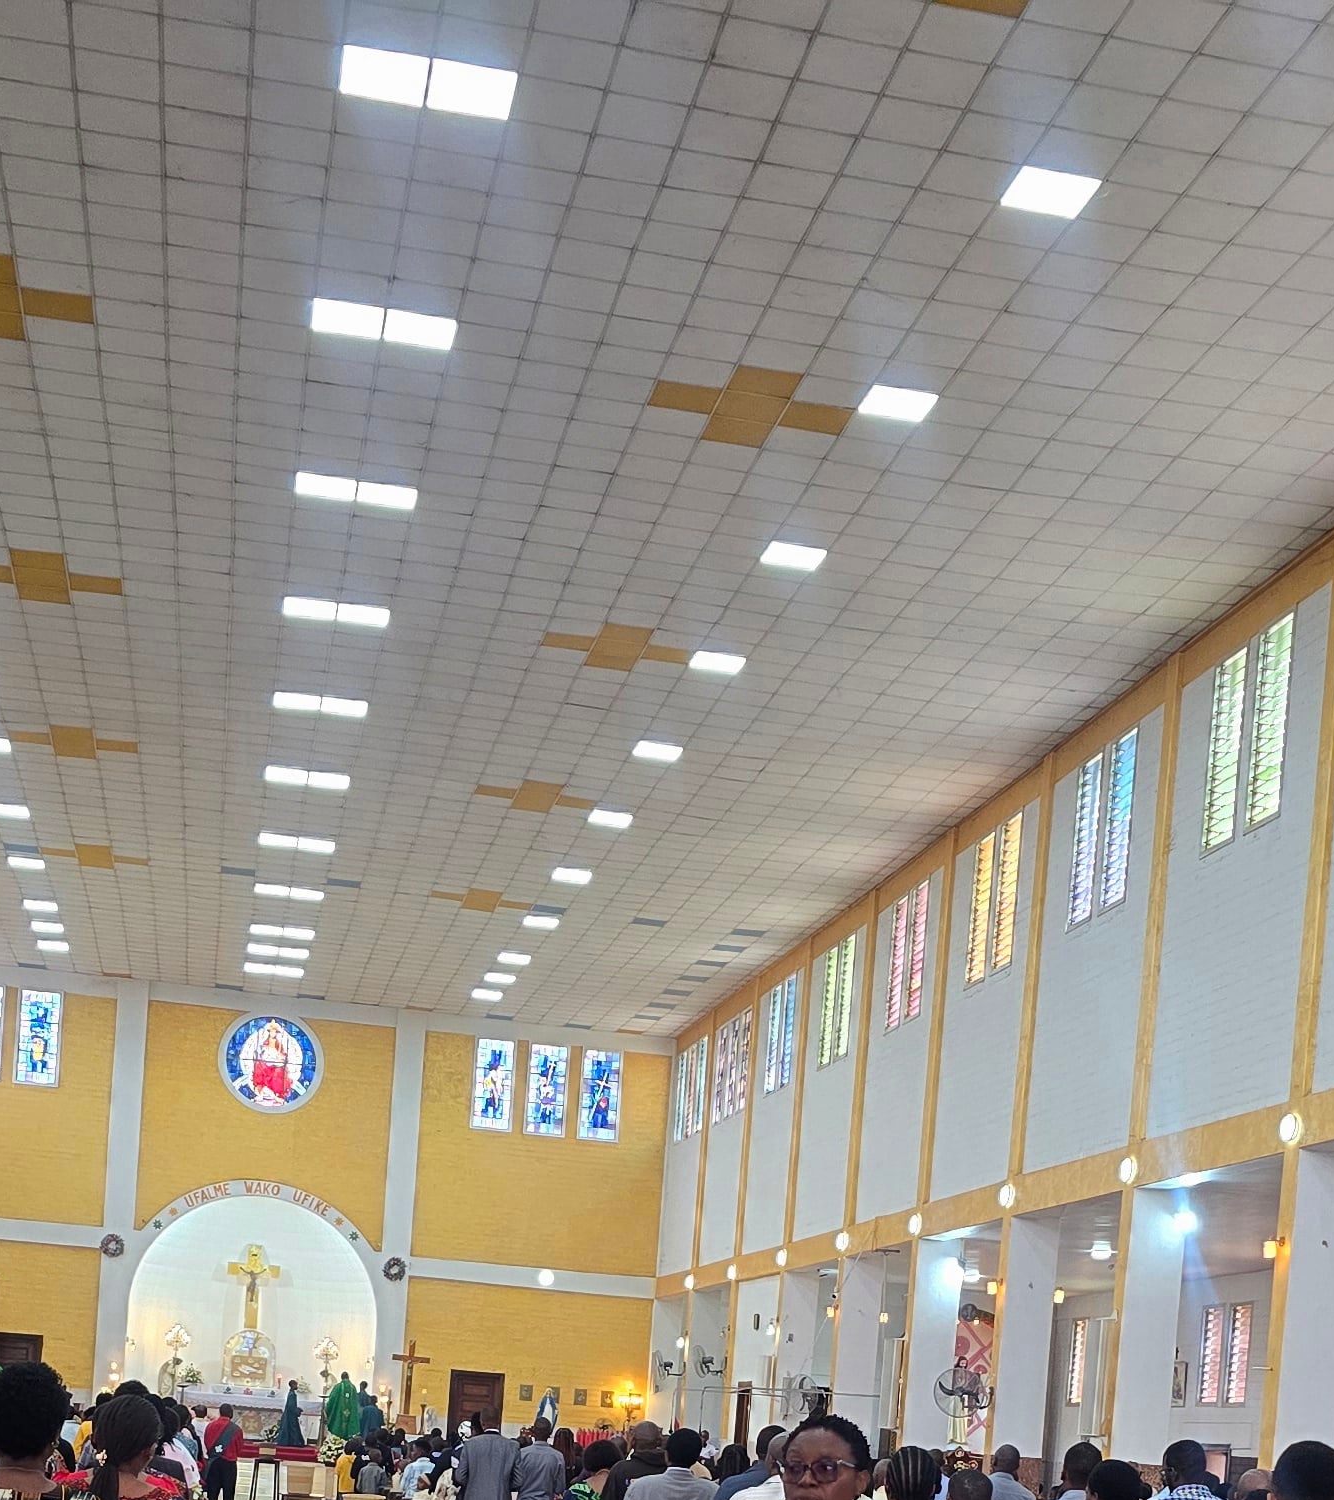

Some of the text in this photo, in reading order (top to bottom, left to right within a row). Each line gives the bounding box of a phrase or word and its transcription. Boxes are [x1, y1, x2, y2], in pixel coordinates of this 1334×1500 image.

[184, 1181, 332, 1217] UFALME WAKO UFIKE
